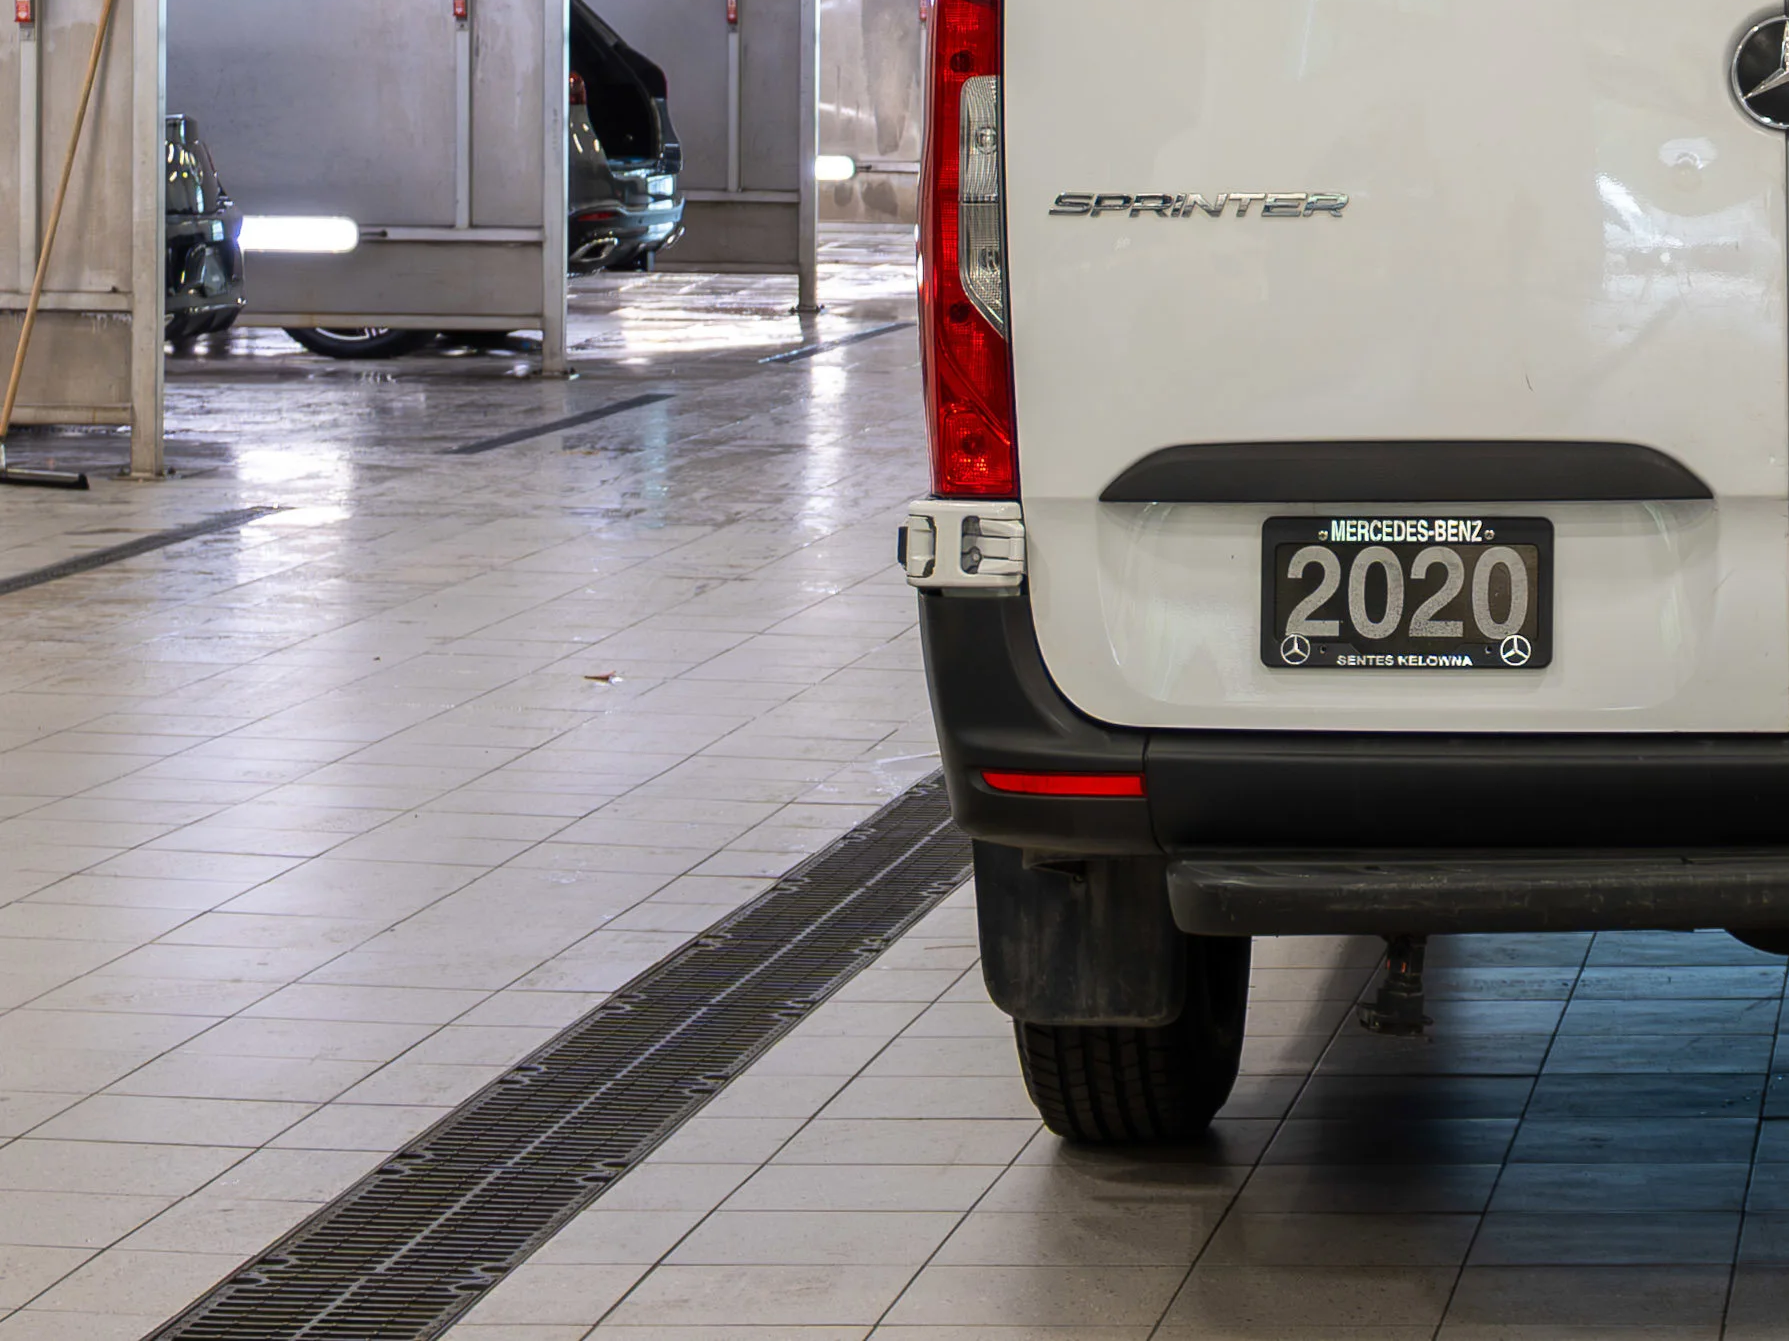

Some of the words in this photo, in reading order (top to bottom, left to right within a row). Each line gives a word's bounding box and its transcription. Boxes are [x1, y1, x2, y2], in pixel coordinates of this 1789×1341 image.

[1049, 192, 1350, 218] SPRINTER
[1331, 520, 1483, 543] MERCEDES-BENZ
[1285, 545, 1529, 640] 2020
[1336, 654, 1395, 667] SENTES
[1398, 654, 1473, 668] KELOWNA
